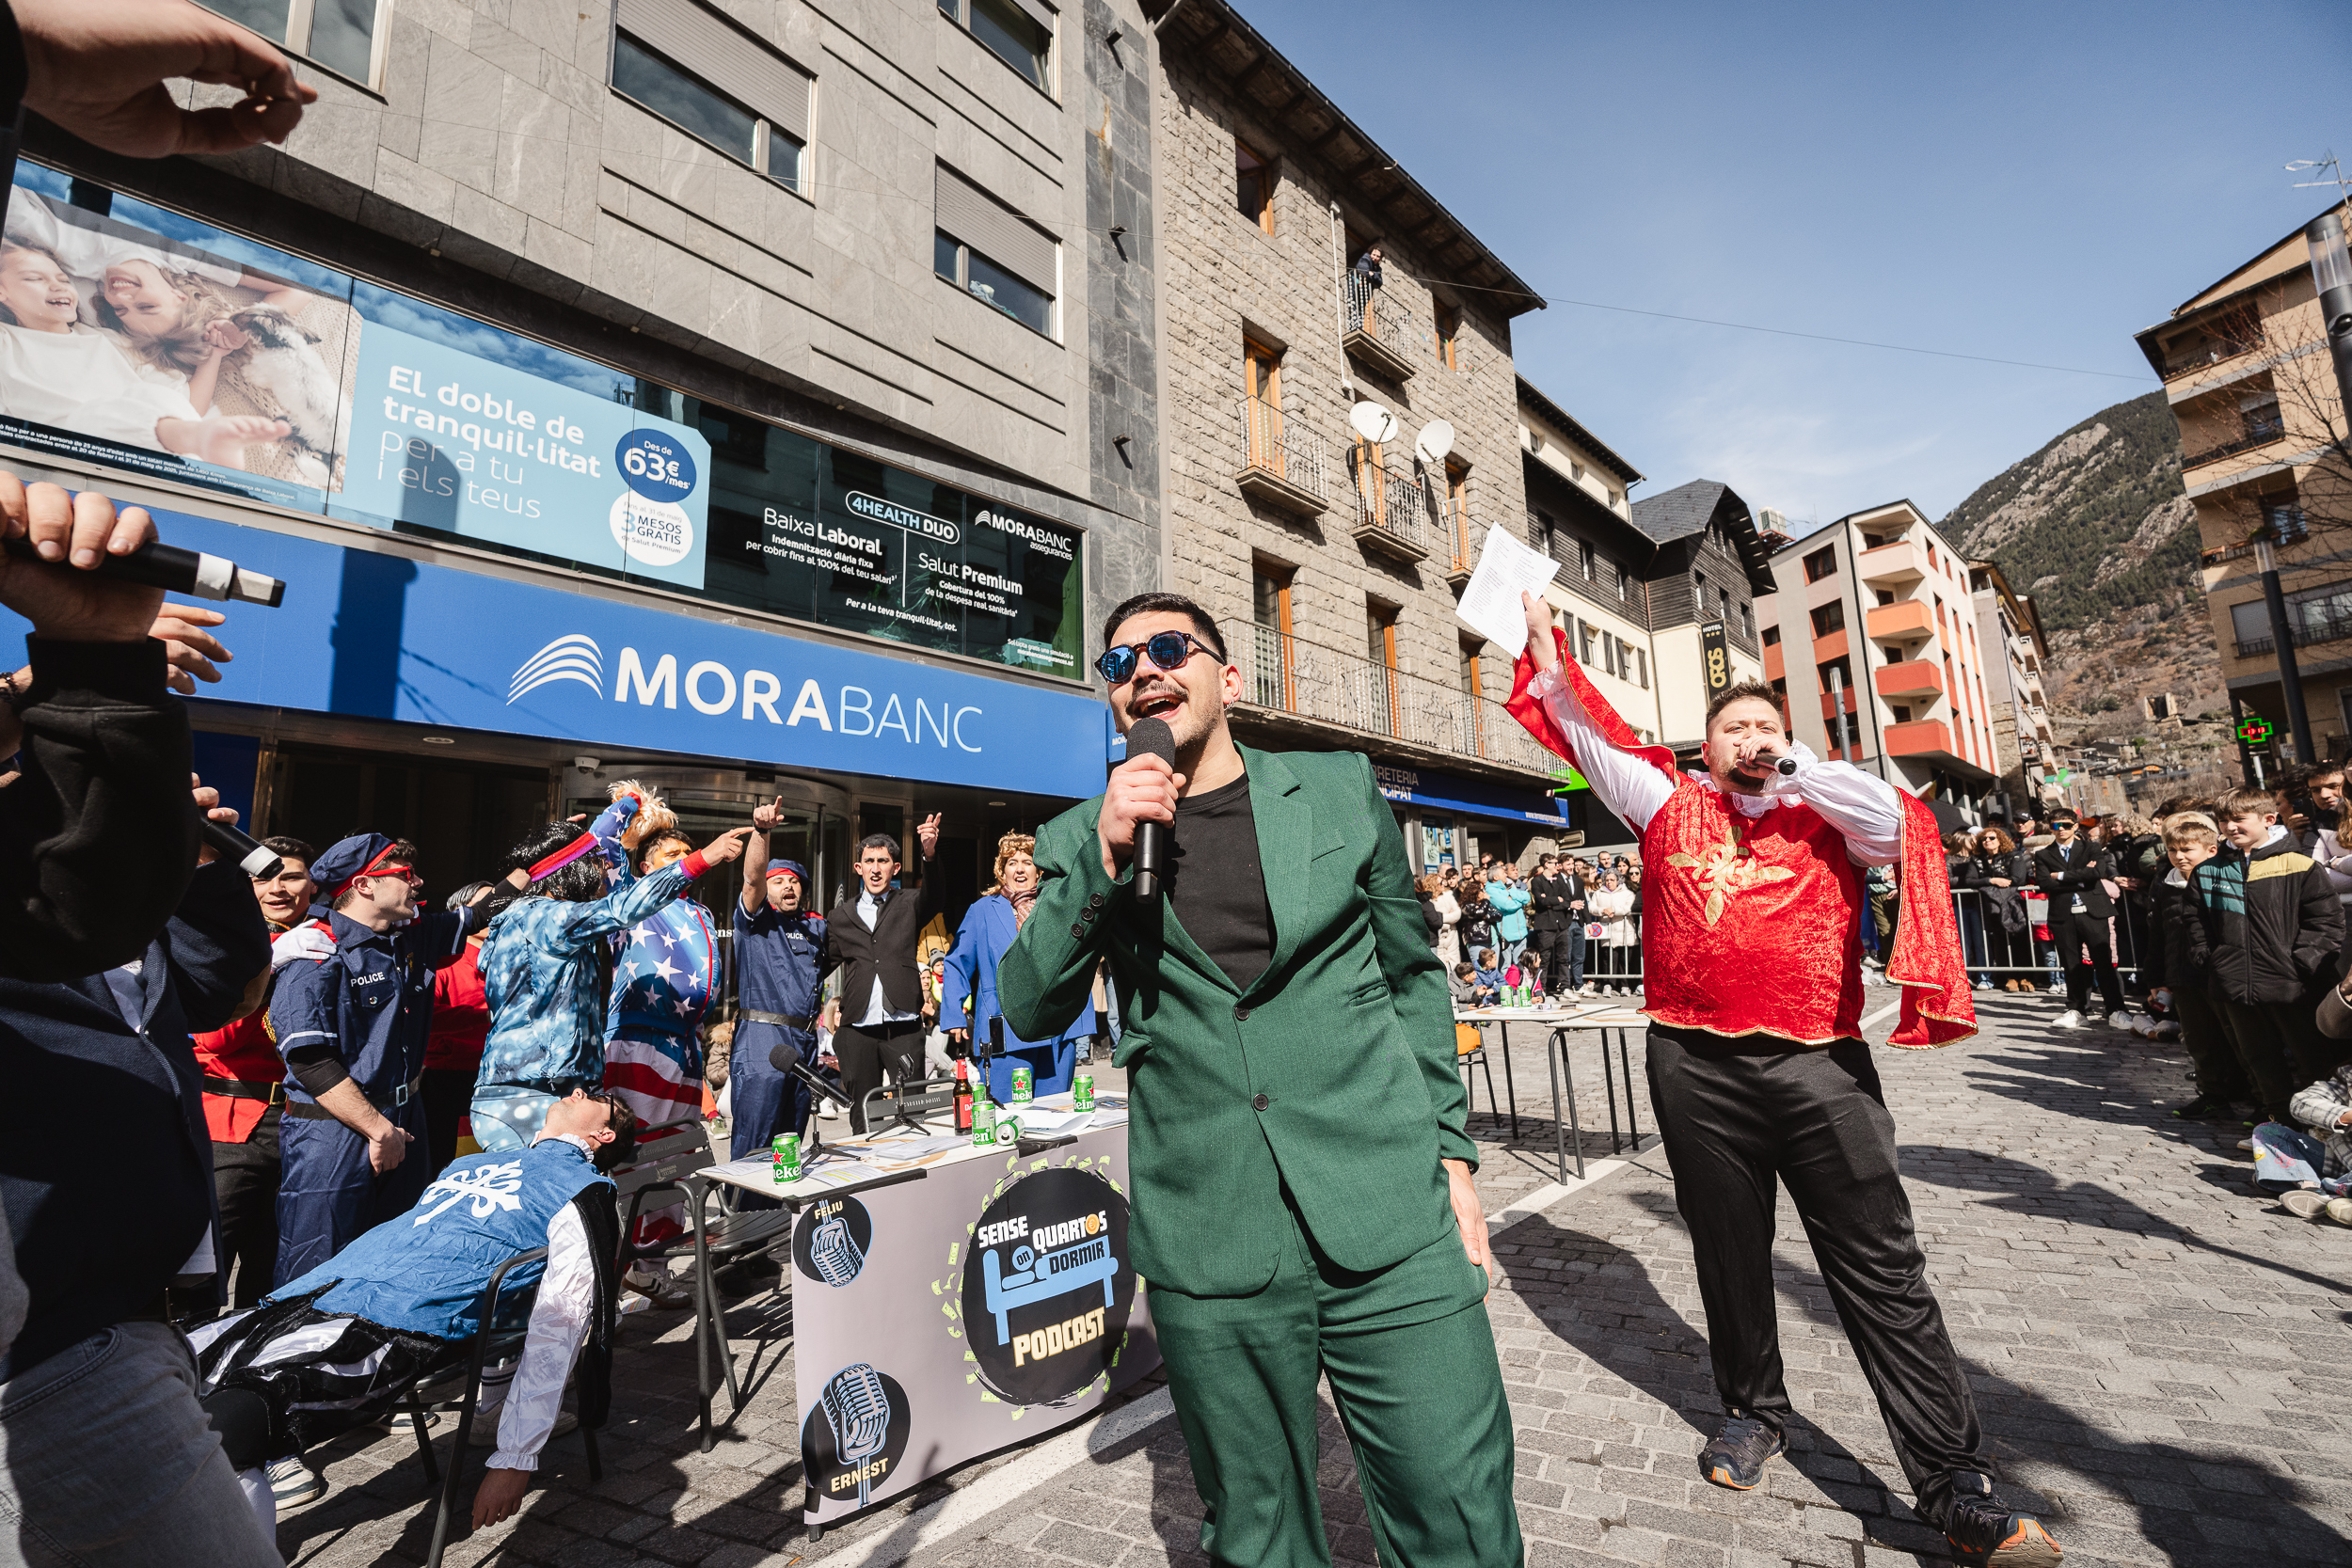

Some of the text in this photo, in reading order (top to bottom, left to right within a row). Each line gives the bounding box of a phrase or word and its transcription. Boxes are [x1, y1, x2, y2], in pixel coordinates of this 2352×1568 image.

[389, 365, 584, 445] El doble de
[50, 435, 74, 445] persona
[383, 395, 601, 479] tranquil·litat
[644, 440, 673, 456] Des de
[380, 431, 523, 485] per a tu
[378, 456, 541, 518] i els teus
[621, 511, 682, 534] 3 MESOS
[624, 500, 638, 511] Fns
[851, 497, 954, 540] 4HEALTH DUO
[631, 535, 650, 546] Salut
[637, 527, 681, 546] GRATIS
[764, 507, 883, 556] Baixa Laboral
[991, 515, 1072, 552] MORABANC
[745, 540, 762, 550] per
[763, 544, 788, 558] cobrir
[789, 550, 805, 562] fins
[806, 555, 816, 565] al
[817, 558, 840, 572] 100%
[841, 564, 855, 576] del
[855, 567, 870, 579] teu
[771, 533, 833, 558] Indemnització
[858, 557, 874, 569] fixa
[1029, 541, 1073, 562] assegurances
[918, 552, 1023, 595] Salut Premium
[925, 587, 935, 596] de
[936, 590, 944, 598] la
[945, 592, 973, 607] despesa
[974, 600, 988, 610] real
[939, 579, 1006, 605] Cobertura del 100%
[846, 597, 860, 609] Per
[867, 602, 877, 612] la
[877, 606, 895, 616] teva
[944, 622, 958, 632] tot.
[1702, 624, 1723, 633] HOTEL
[1707, 647, 1727, 689] OROS
[614, 646, 982, 753] MORABANC
[350, 971, 386, 988] POLICE
[814, 1200, 844, 1220] FELIU
[977, 1215, 1029, 1248] SENSE
[1048, 1241, 1105, 1275] DORMIR
[1012, 1306, 1105, 1368] PODCAST
[831, 1457, 889, 1493] ERNEST
